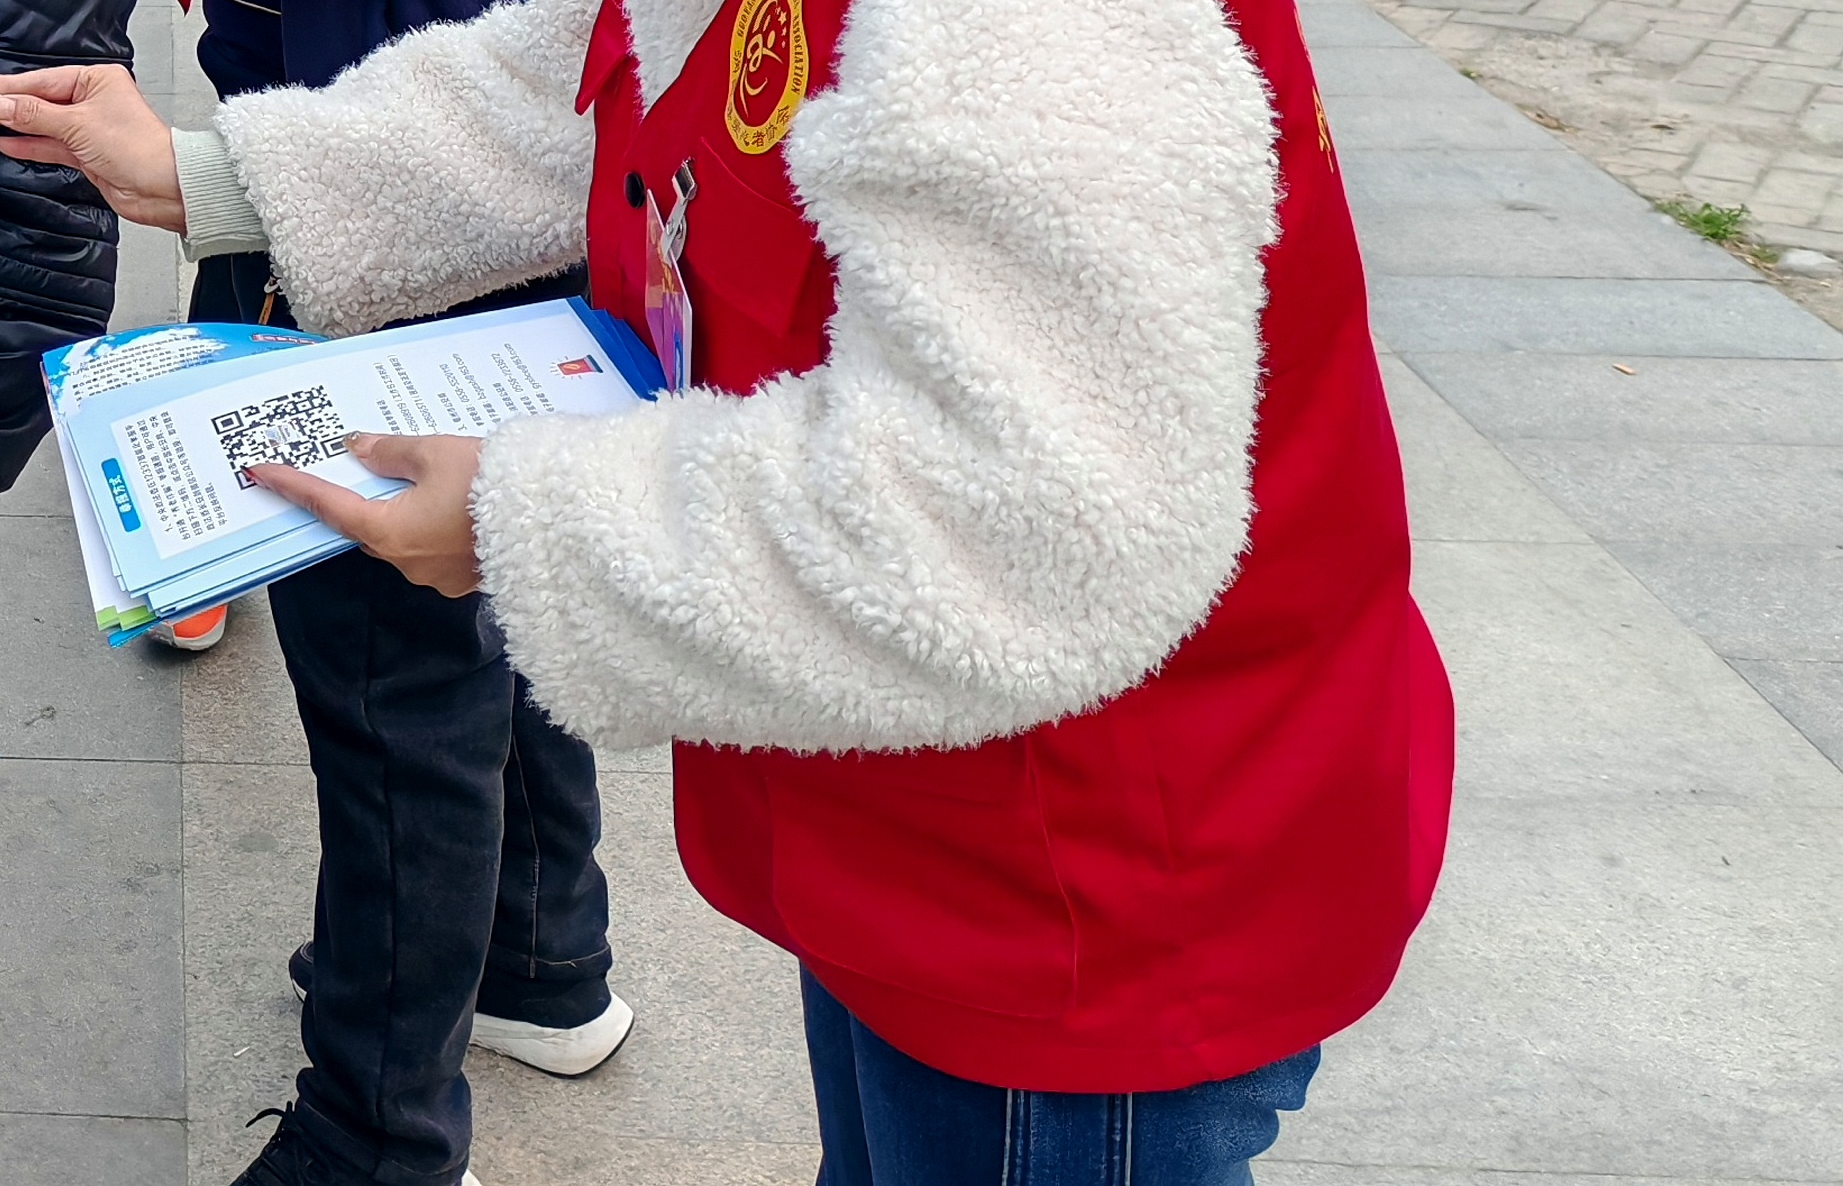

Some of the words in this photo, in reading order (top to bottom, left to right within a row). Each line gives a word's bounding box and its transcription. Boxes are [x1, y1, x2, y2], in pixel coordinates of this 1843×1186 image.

[791, 14, 804, 96] ASSOCIATION
[109, 475, 132, 513] 举报方式
